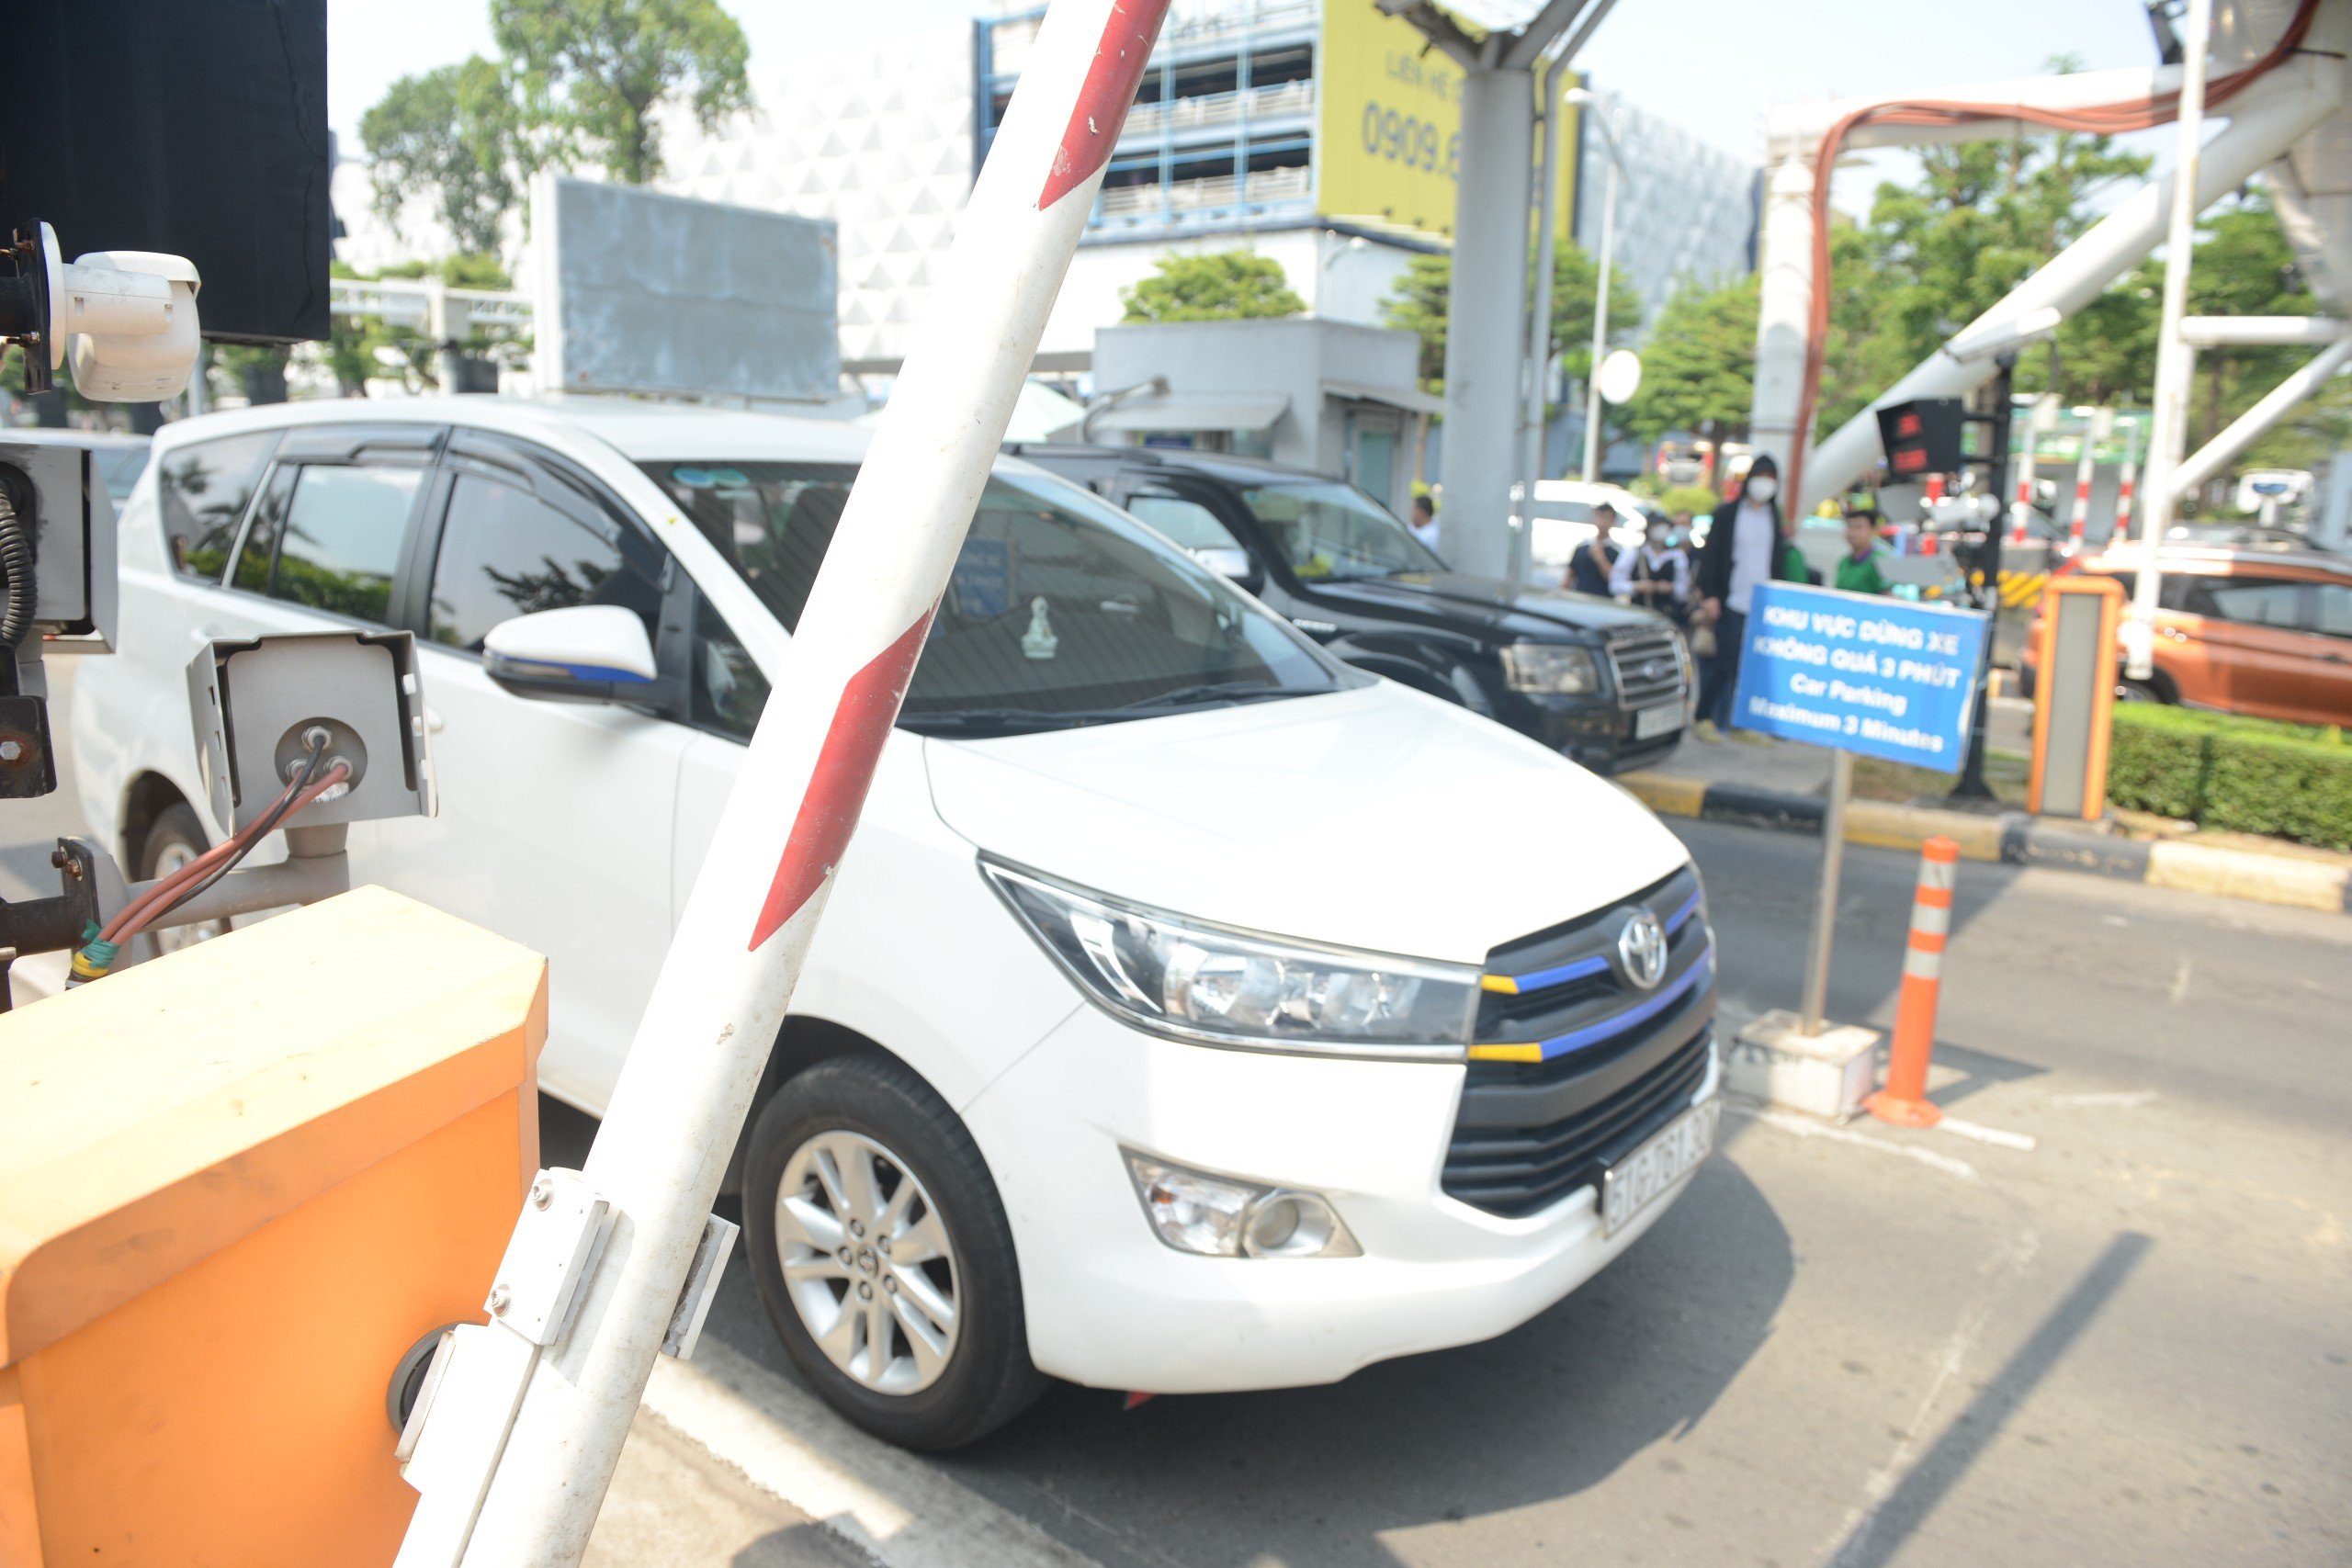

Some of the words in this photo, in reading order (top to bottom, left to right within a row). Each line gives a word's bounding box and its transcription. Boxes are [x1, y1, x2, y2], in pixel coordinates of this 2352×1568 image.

[1762, 604, 1810, 632] KHU
[1811, 613, 1857, 639] VỰC
[1925, 630, 1960, 657] XE
[1752, 635, 1829, 667] KHÔNG
[1829, 648, 1878, 675] QUÁ
[1879, 657, 1897, 679] 3
[1897, 659, 1962, 690] PHÚT
[1789, 672, 1829, 697] Car
[1827, 680, 1908, 716] Parking
[1747, 695, 1841, 732] Maximum
[1841, 714, 1860, 736] 3
[1860, 716, 1944, 753] Minutes
